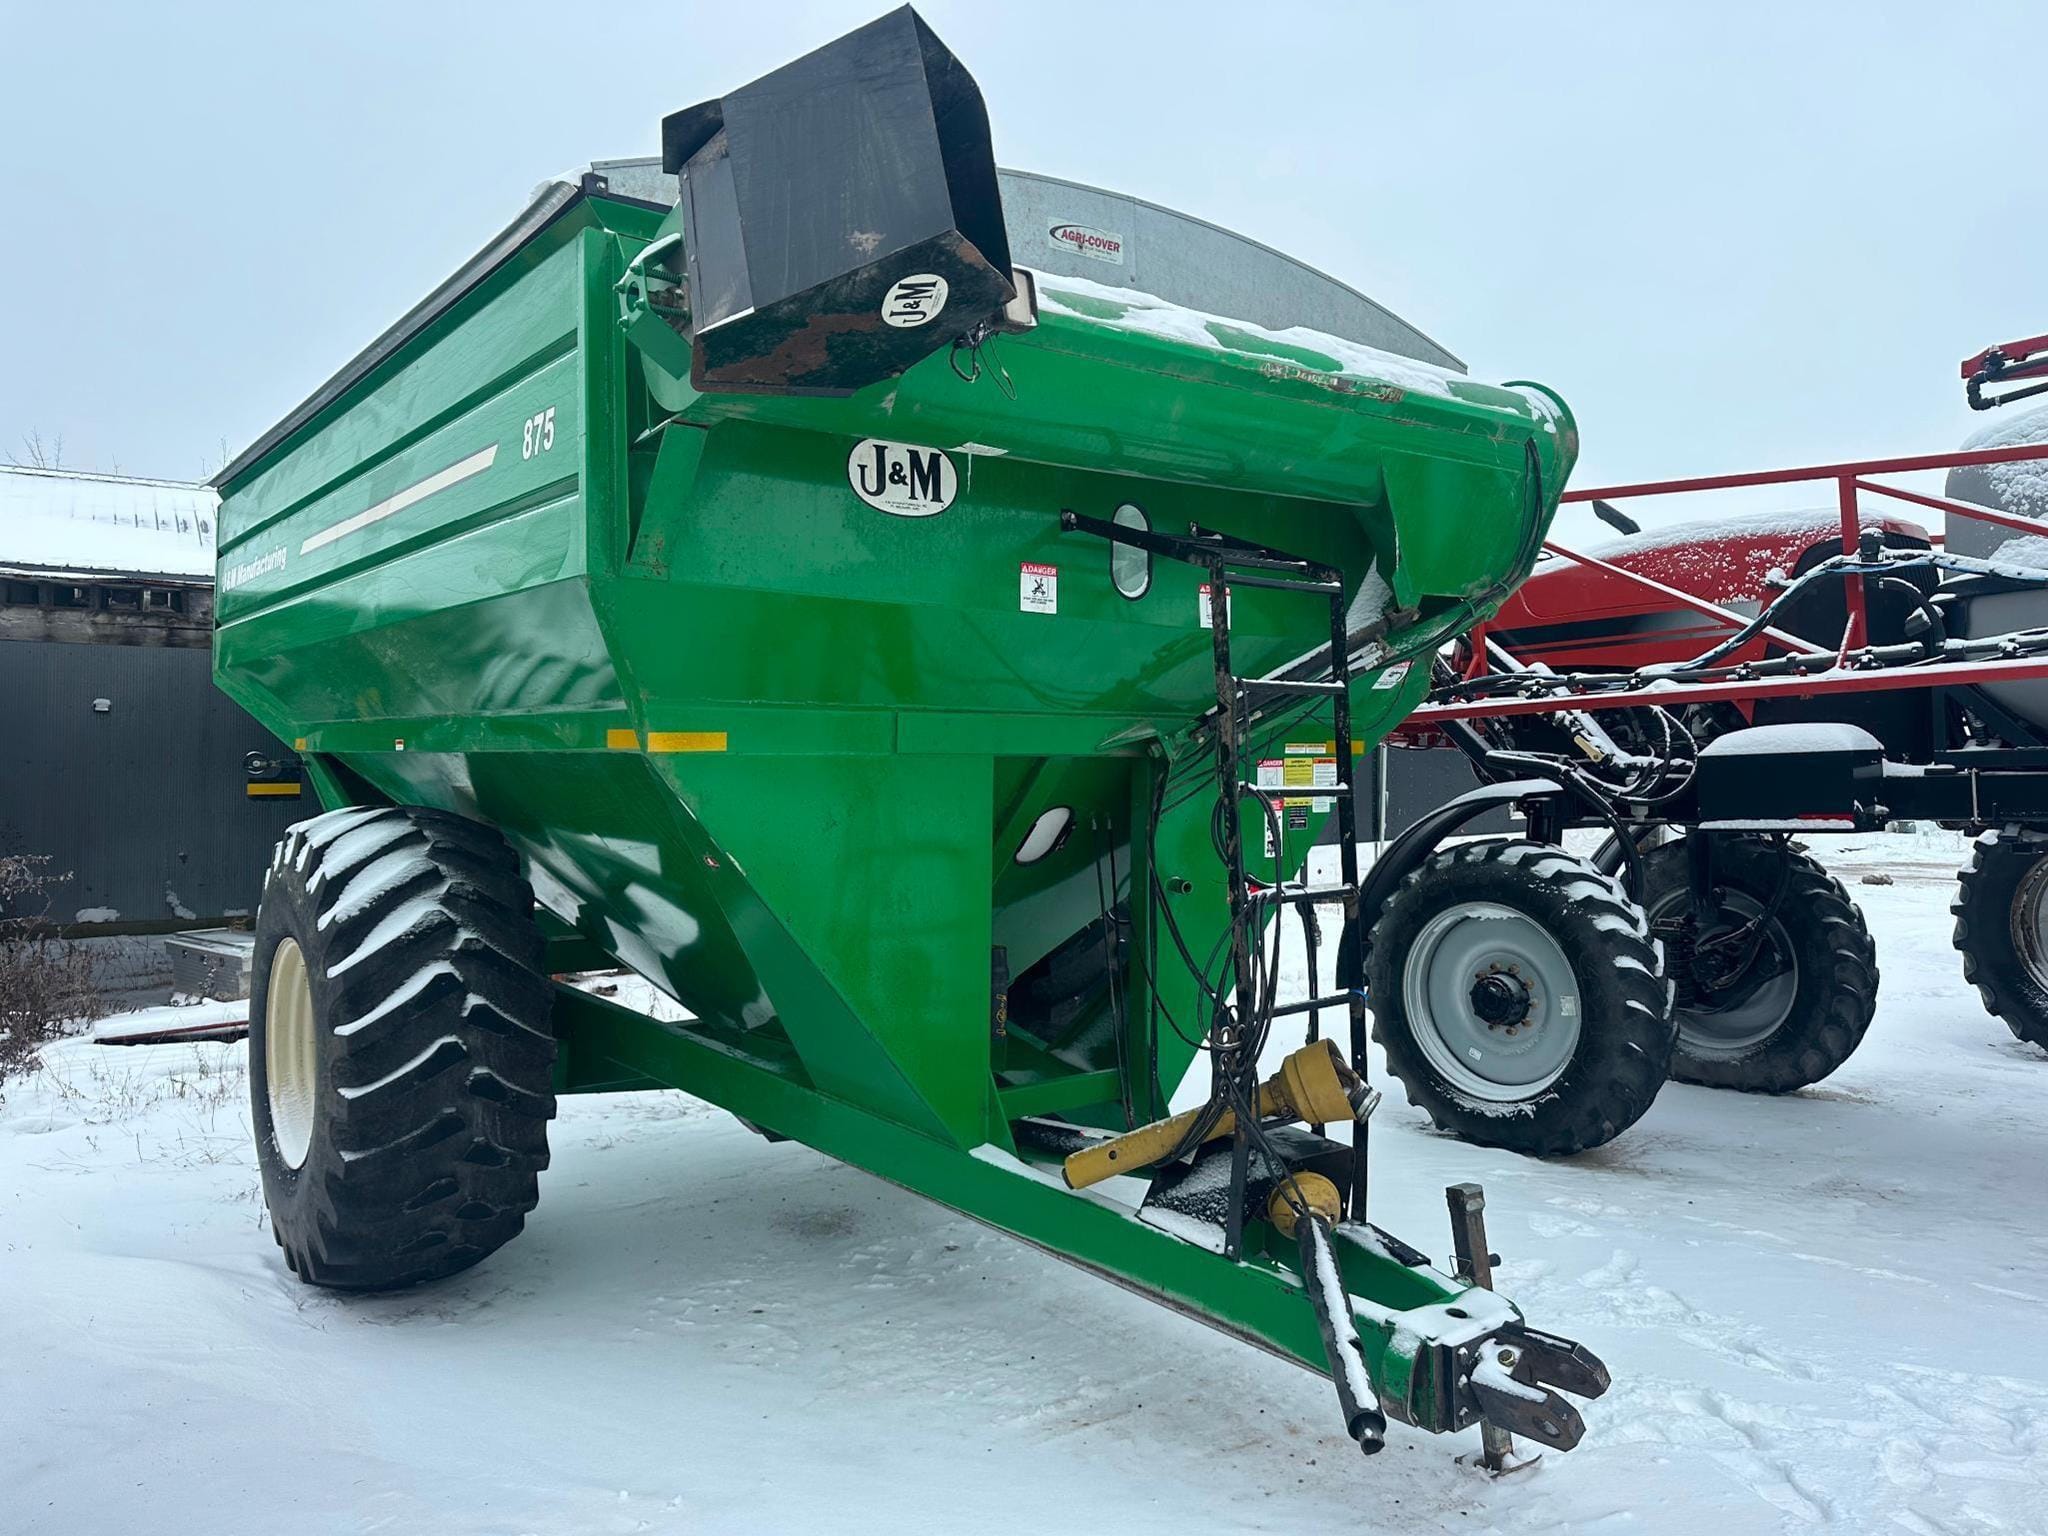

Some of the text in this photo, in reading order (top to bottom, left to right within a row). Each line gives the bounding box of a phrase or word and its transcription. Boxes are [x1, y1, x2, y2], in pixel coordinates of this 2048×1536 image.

[1060, 228, 1121, 253] AGRI-COVER
[889, 279, 939, 325] J&M
[522, 405, 556, 460] 875
[856, 444, 945, 503] J&M
[237, 545, 287, 587] Manufacturing
[1028, 565, 1057, 576] DANGER
